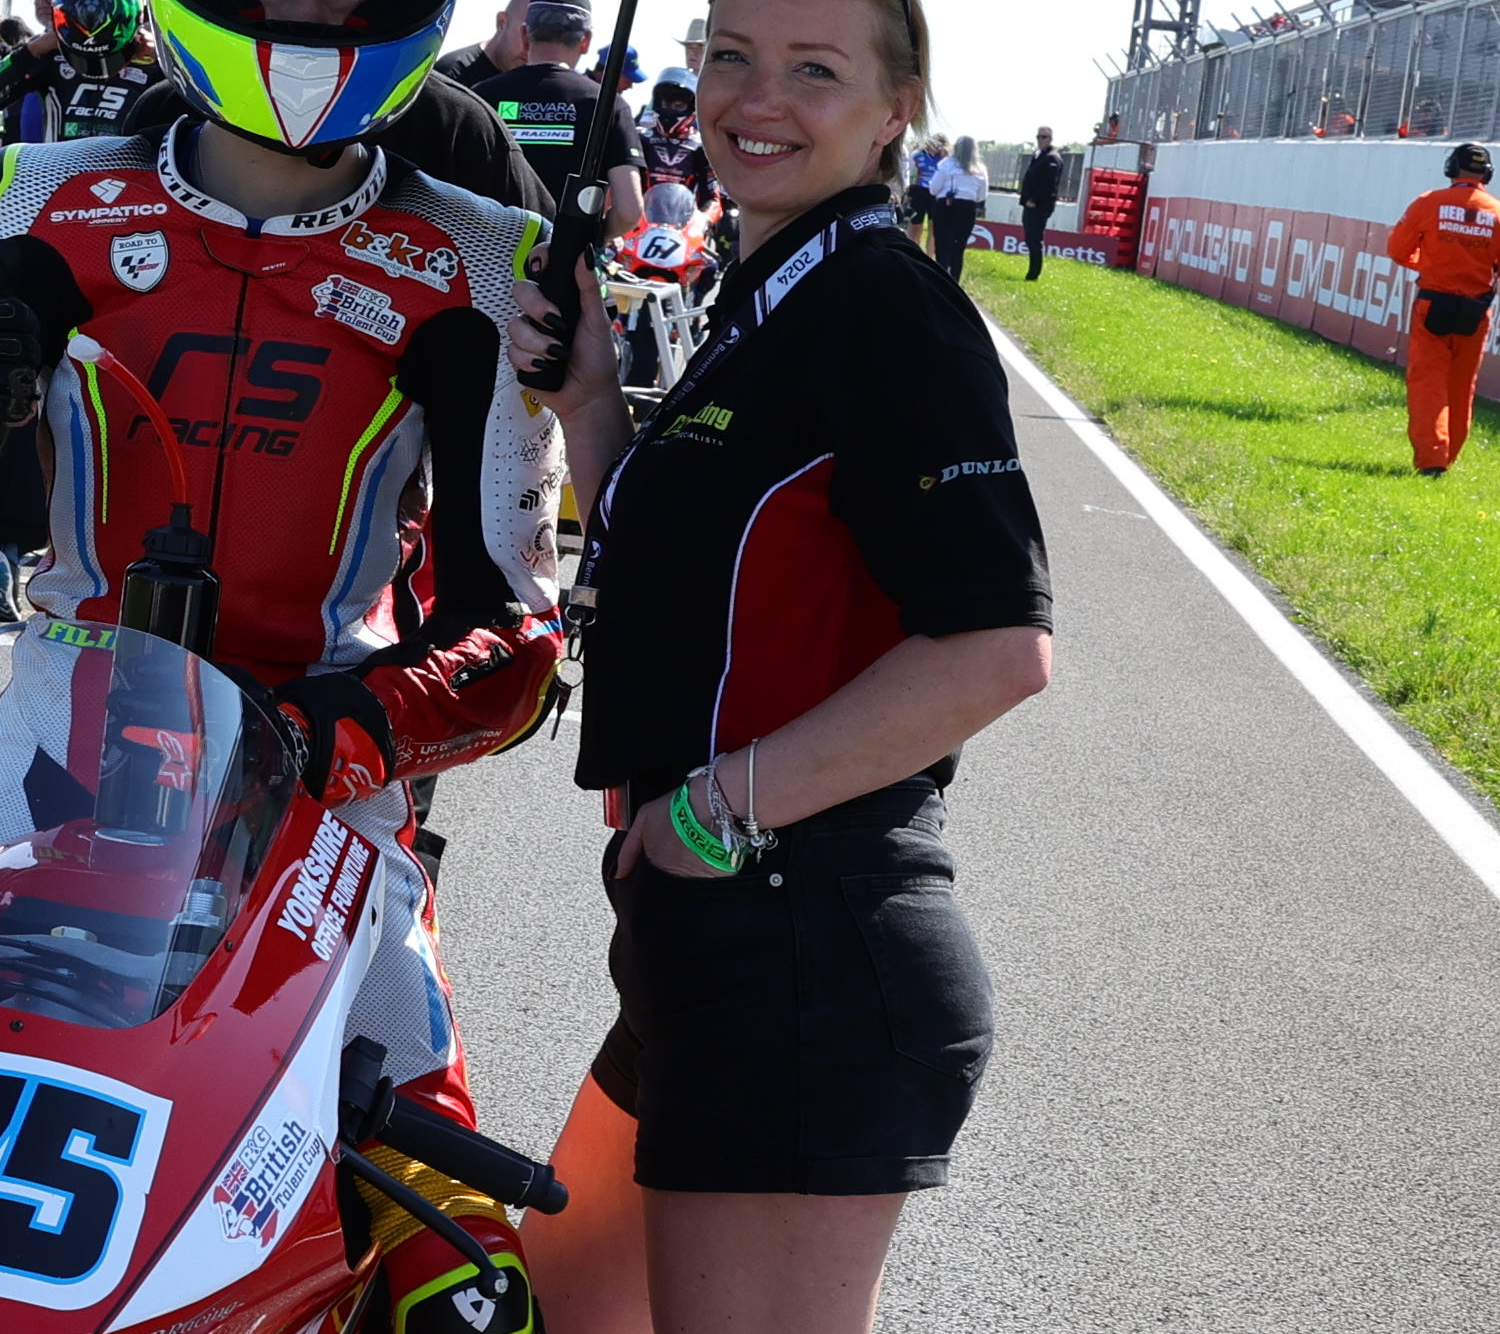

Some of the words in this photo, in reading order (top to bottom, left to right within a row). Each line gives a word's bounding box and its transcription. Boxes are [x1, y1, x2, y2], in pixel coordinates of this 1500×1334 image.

[518, 111, 577, 122] PROJECTS
[519, 101, 577, 113] KOVARA
[520, 129, 571, 138] RACING
[50, 202, 169, 224] SYMPATICO
[88, 217, 129, 226] JOINERY
[117, 239, 144, 249] ROAD
[341, 222, 423, 267] b&k
[1438, 221, 1493, 238] WORKWEAR
[642, 234, 681, 261] 67
[1002, 235, 1107, 265] Benetts
[776, 250, 815, 287] 2024
[338, 312, 376, 335] Talent
[375, 324, 398, 344] Cup
[339, 296, 402, 331] British
[276, 808, 349, 942] YORKSHIRE
[310, 902, 347, 962] OFFICE
[330, 835, 371, 915] FURNITURE
[240, 1125, 272, 1168] R&G
[244, 1118, 307, 1208] British
[273, 1160, 307, 1211] Talent
[301, 1137, 323, 1170] Cup
